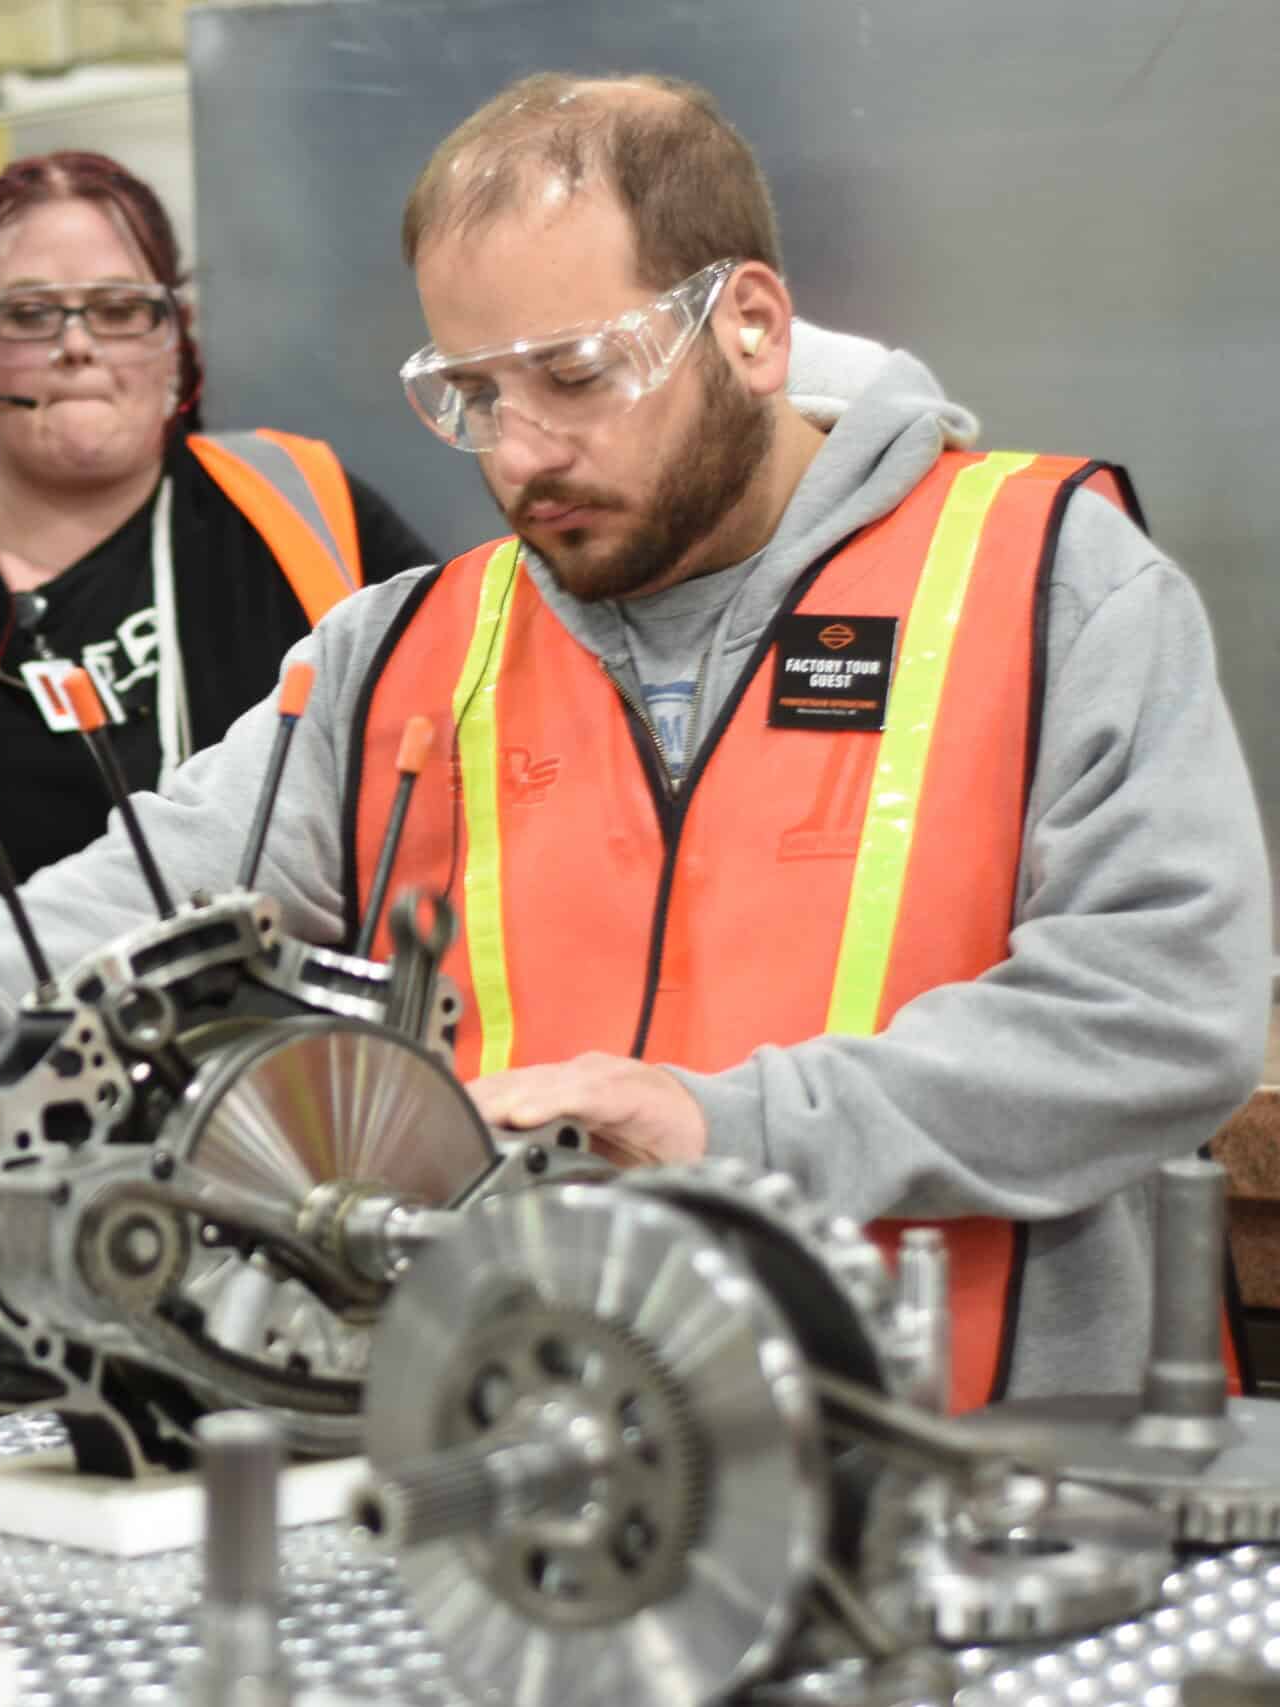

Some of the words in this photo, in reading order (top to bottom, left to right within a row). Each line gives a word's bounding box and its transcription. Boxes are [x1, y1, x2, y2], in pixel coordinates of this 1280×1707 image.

[784, 658, 843, 673] FACTORY
[845, 660, 881, 674] TOUR
[808, 673, 853, 688] GUEST
